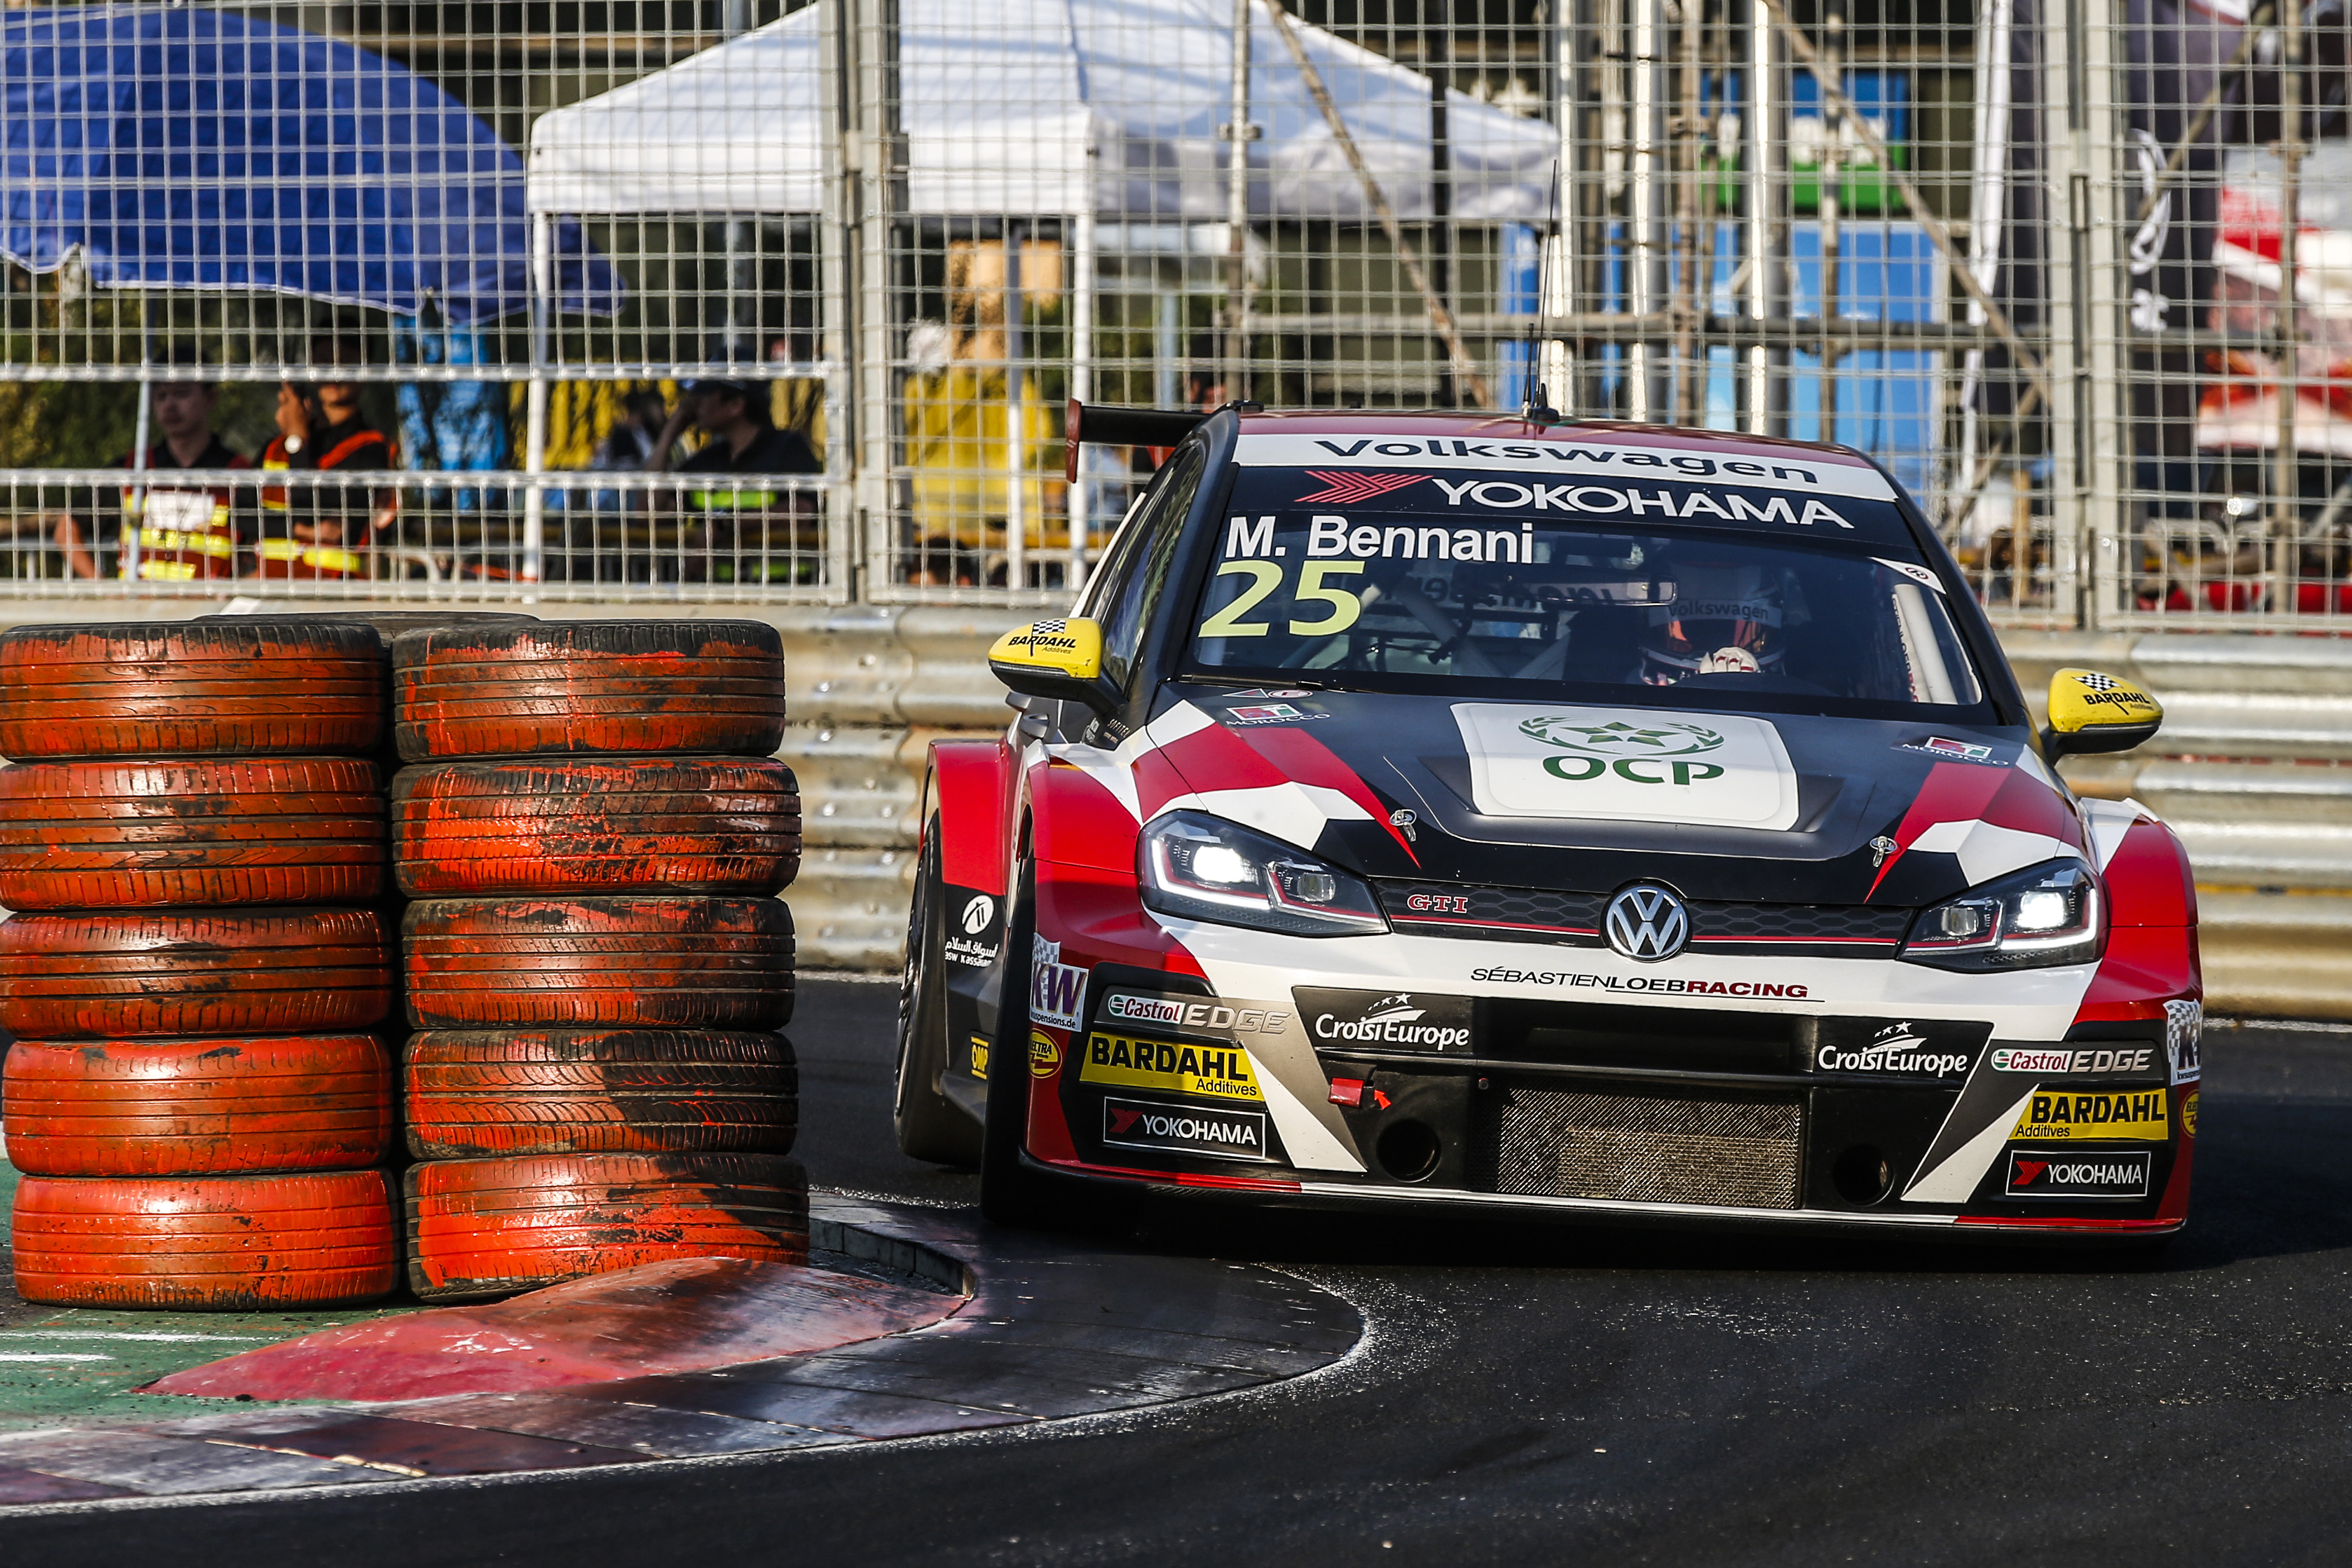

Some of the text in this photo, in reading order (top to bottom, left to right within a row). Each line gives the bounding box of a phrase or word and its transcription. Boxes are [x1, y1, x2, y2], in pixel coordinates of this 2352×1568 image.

[1313, 438, 1817, 484] Volkswagen
[1432, 478, 1855, 529] YOKOHAMA
[1225, 515, 1532, 563] M. Bennani
[1197, 560, 1365, 638] 25
[1008, 636, 1077, 649] BARDAHL
[2083, 692, 2150, 705] BARDAHL
[1107, 719, 1131, 738] SOFITEL
[1226, 714, 1330, 725] MOROCCO
[1902, 743, 2009, 766] MOROCCO
[1542, 755, 1725, 787] OCP
[1406, 893, 1468, 913] GTI
[945, 936, 972, 953] السلام
[1031, 962, 1087, 1017] KW
[1124, 997, 1293, 1035] Castrol EDGE
[1315, 1011, 1469, 1051] CroisiEurope
[1090, 1037, 1248, 1081] BARDAHL
[1818, 1045, 1967, 1078] CroisiEurope
[2010, 1049, 2154, 1073] Castrol EDGE
[1195, 1078, 1257, 1096] Additives
[2031, 1093, 2165, 1125] BARDAHL
[1143, 1114, 1257, 1146] YOKOHAMA
[2015, 1125, 2070, 1138] Additives
[2048, 1164, 2142, 1185] YOKOHAMA
